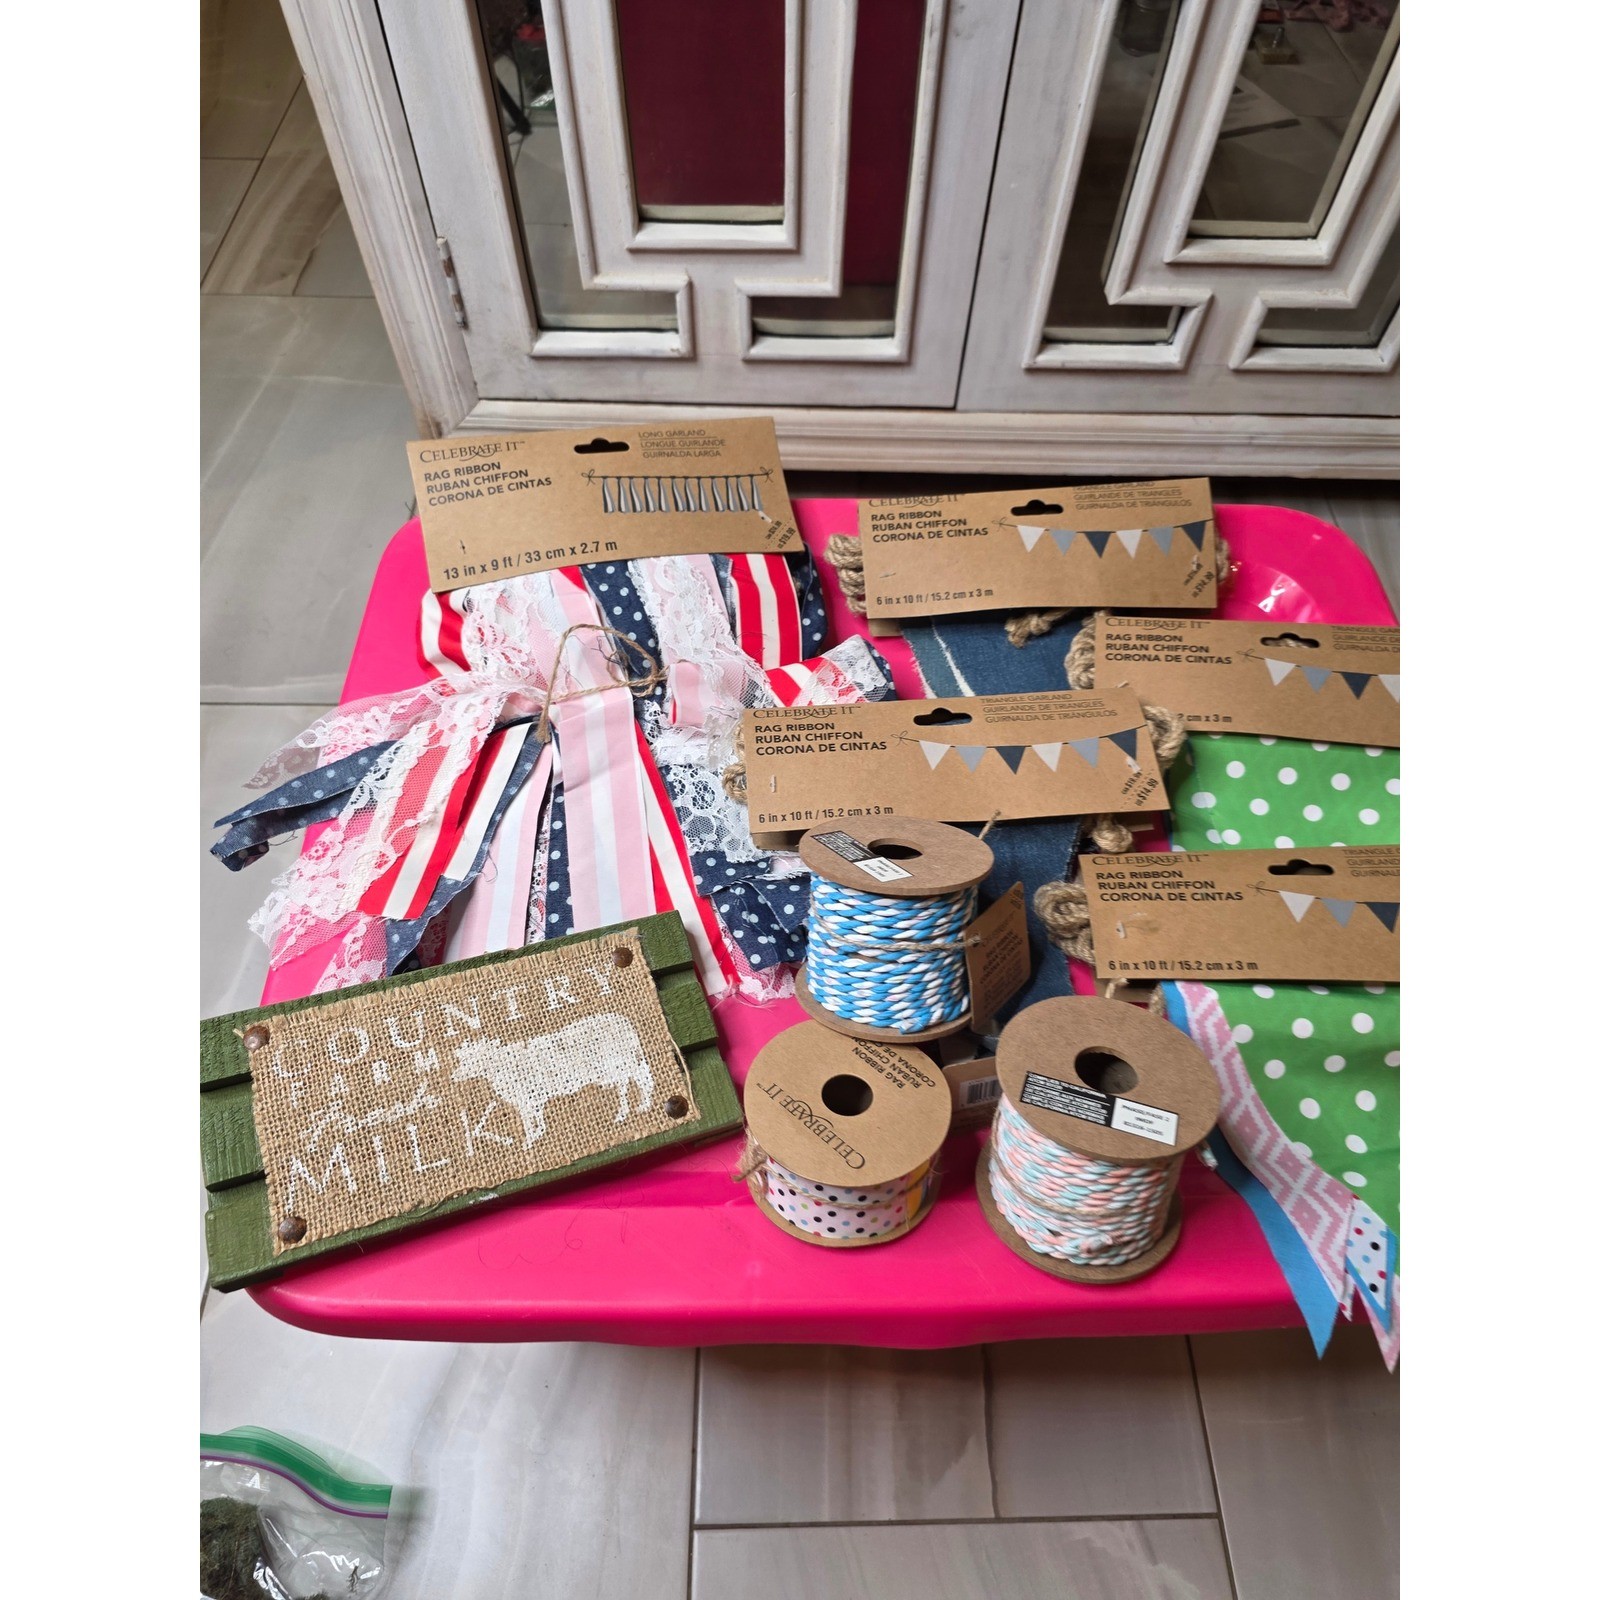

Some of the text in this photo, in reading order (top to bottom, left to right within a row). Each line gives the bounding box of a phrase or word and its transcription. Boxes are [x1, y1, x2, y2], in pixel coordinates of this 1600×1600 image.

[640, 440, 677, 448] LONGUE
[420, 442, 503, 463] CELEBRATE
[424, 462, 500, 482] RAG RIBBON
[427, 469, 528, 494] RUBAN CHIFFON
[428, 477, 552, 506] CORONA DE CINTAS
[868, 495, 944, 508] CELEBRATE
[871, 510, 942, 522] RAG RIBBON
[872, 518, 967, 532] RUBAN CHIFFON
[873, 528, 988, 542] CORONA DE CINTAS
[444, 568, 459, 580] 13
[464, 566, 476, 577] in
[480, 564, 488, 574] x
[491, 559, 498, 570] 9
[503, 556, 513, 568] ft
[524, 551, 542, 563] 33
[546, 547, 566, 560] cm
[569, 546, 577, 556] x
[580, 541, 600, 554] 2.7
[606, 541, 618, 551] m
[876, 596, 882, 605] 6
[885, 596, 894, 604] in
[904, 595, 914, 604] 10
[916, 594, 924, 602] ft
[931, 592, 950, 602] 15.2
[952, 591, 966, 600] cm
[968, 590, 974, 598] x
[976, 589, 982, 597] 3
[1105, 618, 1187, 630] CELEBRATE
[1136, 634, 1183, 642] RIBBON
[1106, 643, 1210, 653] RUBAN CHIFFON
[1105, 652, 1232, 664] CORONA DE CINTAS
[753, 707, 838, 720] CELEBRATE
[1212, 714, 1220, 722] 3
[755, 722, 834, 732] RAG RIBBON
[756, 731, 862, 744] RUBAN CHIFFON
[756, 742, 887, 756] CORONA DE CINTAS
[1136, 778, 1159, 800] $14.99
[759, 814, 766, 823] 6
[768, 813, 778, 822] in
[780, 814, 787, 822] x
[790, 812, 802, 820] 10
[805, 810, 812, 820] ft
[822, 808, 844, 818] 15.2
[848, 808, 862, 816] cm
[866, 807, 872, 815] x
[874, 806, 880, 814] 3
[884, 806, 894, 814] m
[1092, 855, 1184, 867] CELEBRATE
[1096, 870, 1184, 880] RAG RIBBON
[1098, 880, 1215, 890] RUBAN CHIFFON
[1100, 892, 1244, 902] CORONA DE CINTAS
[1108, 960, 1116, 970] 6
[1119, 960, 1130, 970] in
[1133, 962, 1140, 970] x
[1142, 960, 1156, 970] 10
[1159, 960, 1168, 970] ft
[1178, 960, 1202, 970] 15.2
[1206, 961, 1223, 970] cm
[1226, 962, 1233, 970] x
[1236, 960, 1244, 970] 3
[1247, 962, 1258, 970] m
[272, 963, 613, 1078] COUNTRY
[852, 1037, 922, 1088] RUBAN CHIFFON
[852, 1047, 906, 1088] RAG RIBBON
[883, 1046, 936, 1088] CORONA DE
[291, 1048, 440, 1108] FARM
[779, 1095, 866, 1169] CELEBRATE
[286, 1101, 515, 1213] MILK
